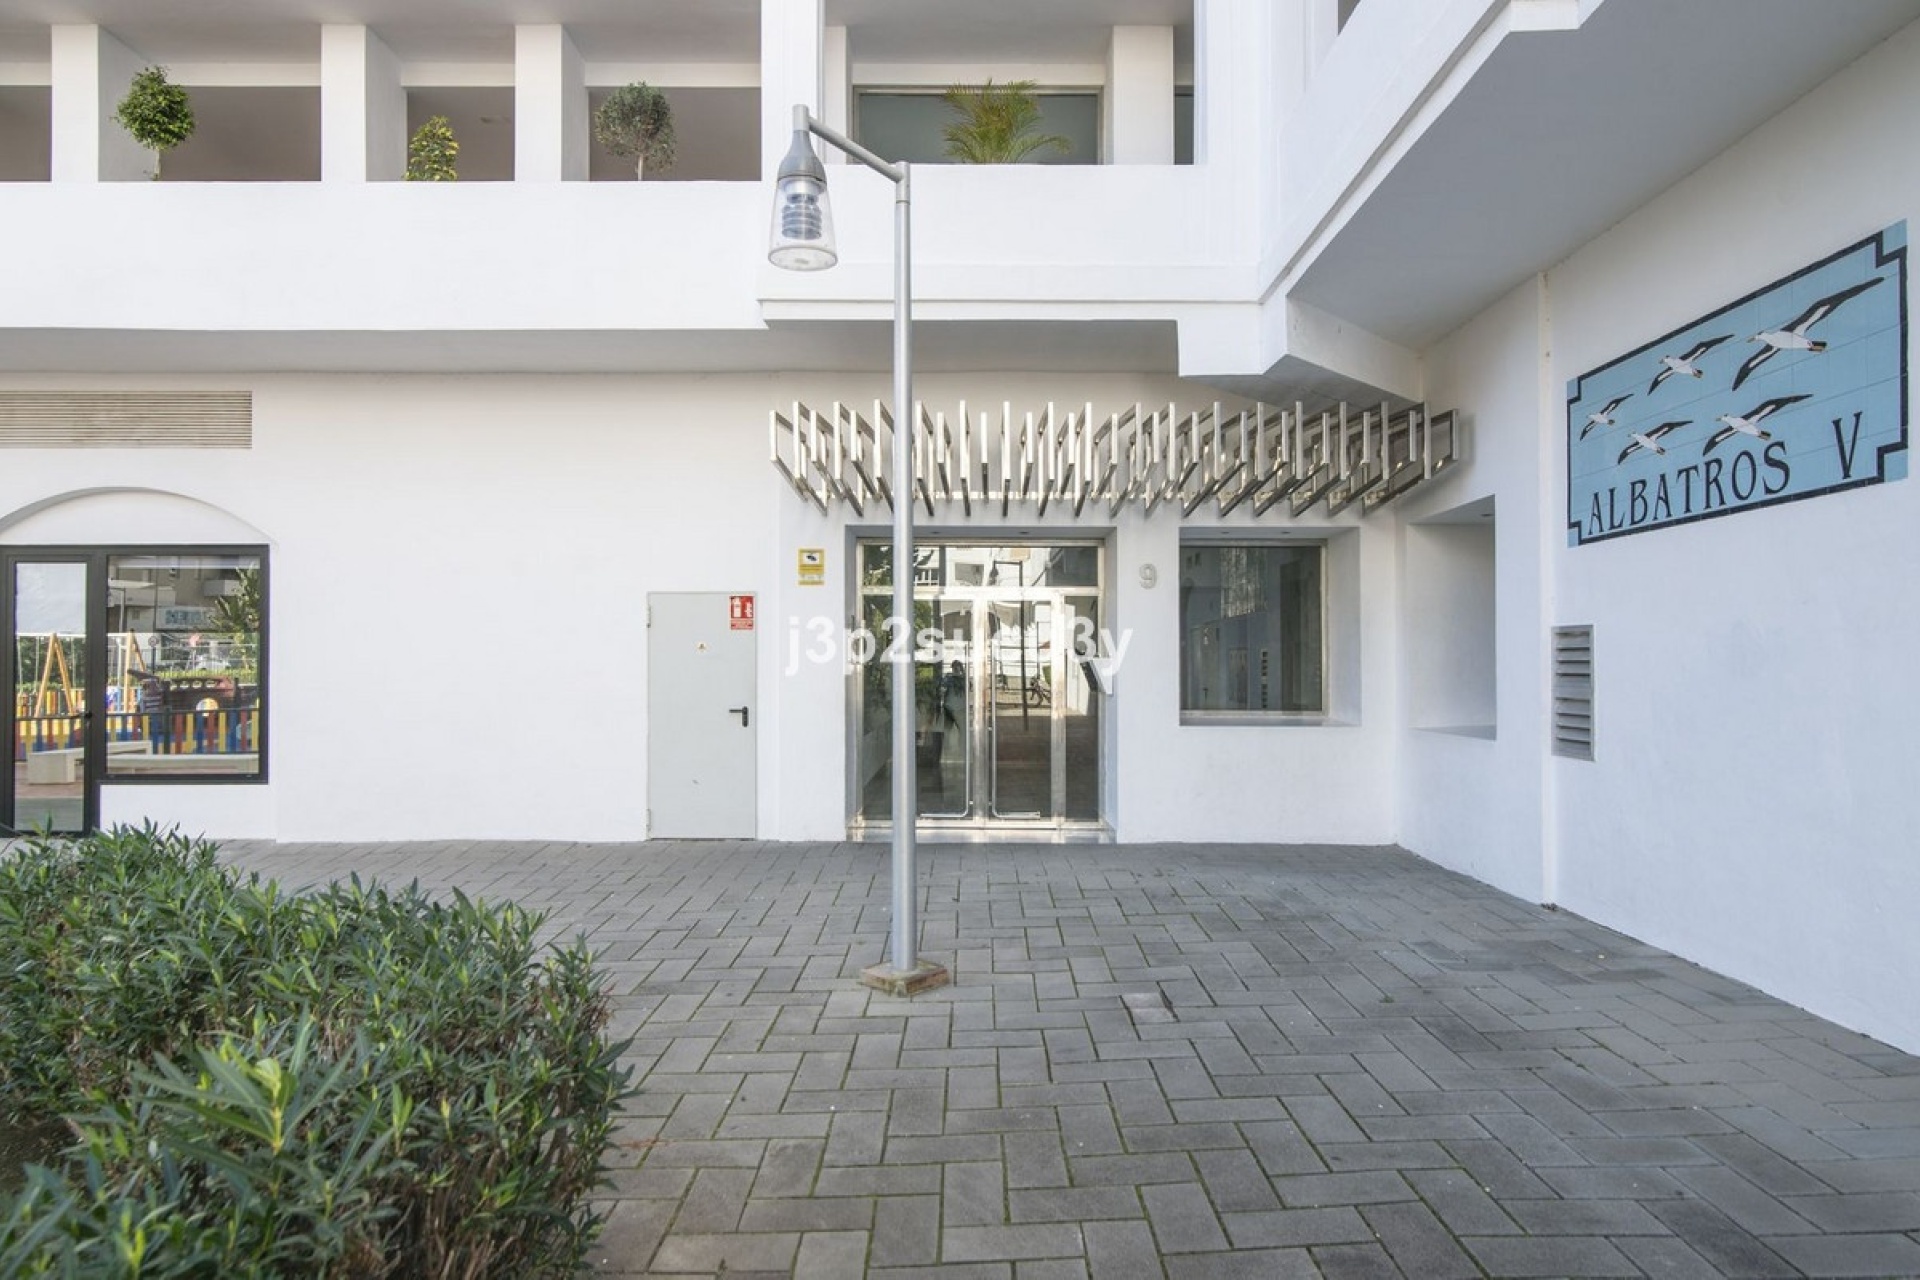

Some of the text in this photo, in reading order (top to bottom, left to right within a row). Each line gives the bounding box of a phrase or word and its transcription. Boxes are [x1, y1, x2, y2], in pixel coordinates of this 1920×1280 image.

[1588, 411, 1863, 535] ALBATROS V
[1139, 563, 1158, 590] 9
